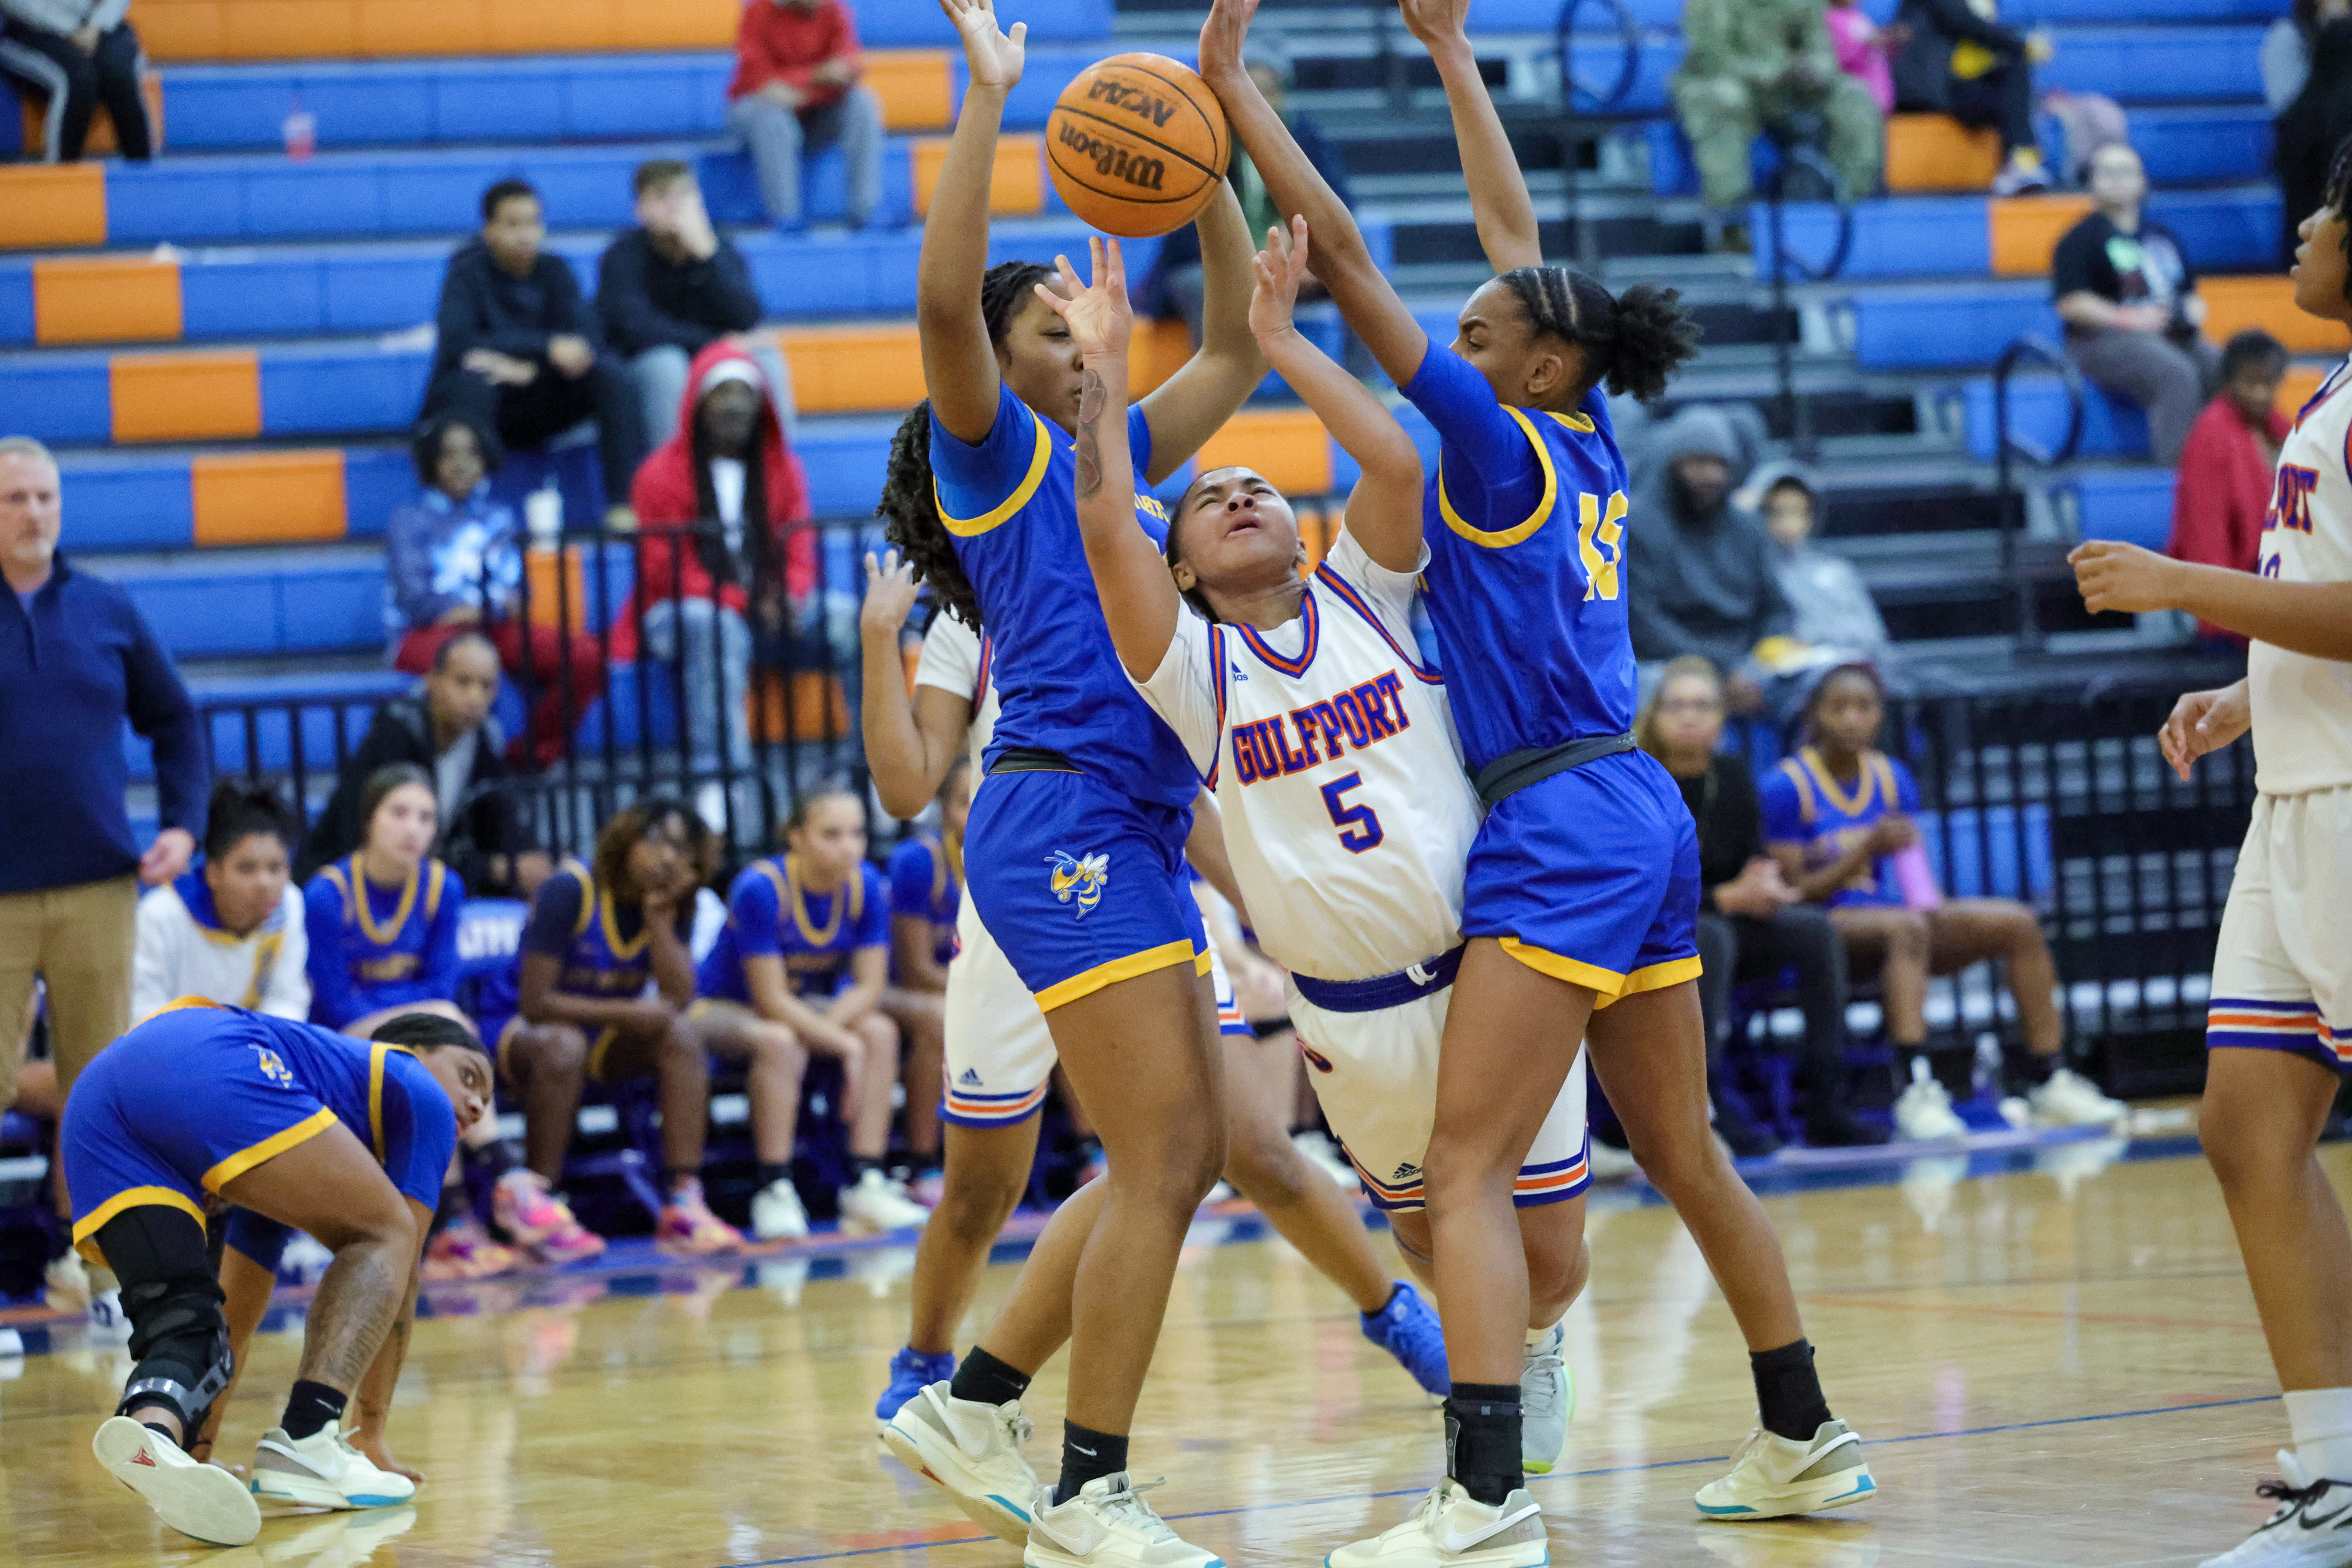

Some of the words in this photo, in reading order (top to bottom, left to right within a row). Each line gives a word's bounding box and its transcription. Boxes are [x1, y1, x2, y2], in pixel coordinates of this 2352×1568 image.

[1088, 79, 1174, 127] NCAA
[1060, 119, 1165, 190] Wilson
[1232, 669, 1411, 787] GULFPORT
[1319, 771, 1385, 854] 5
